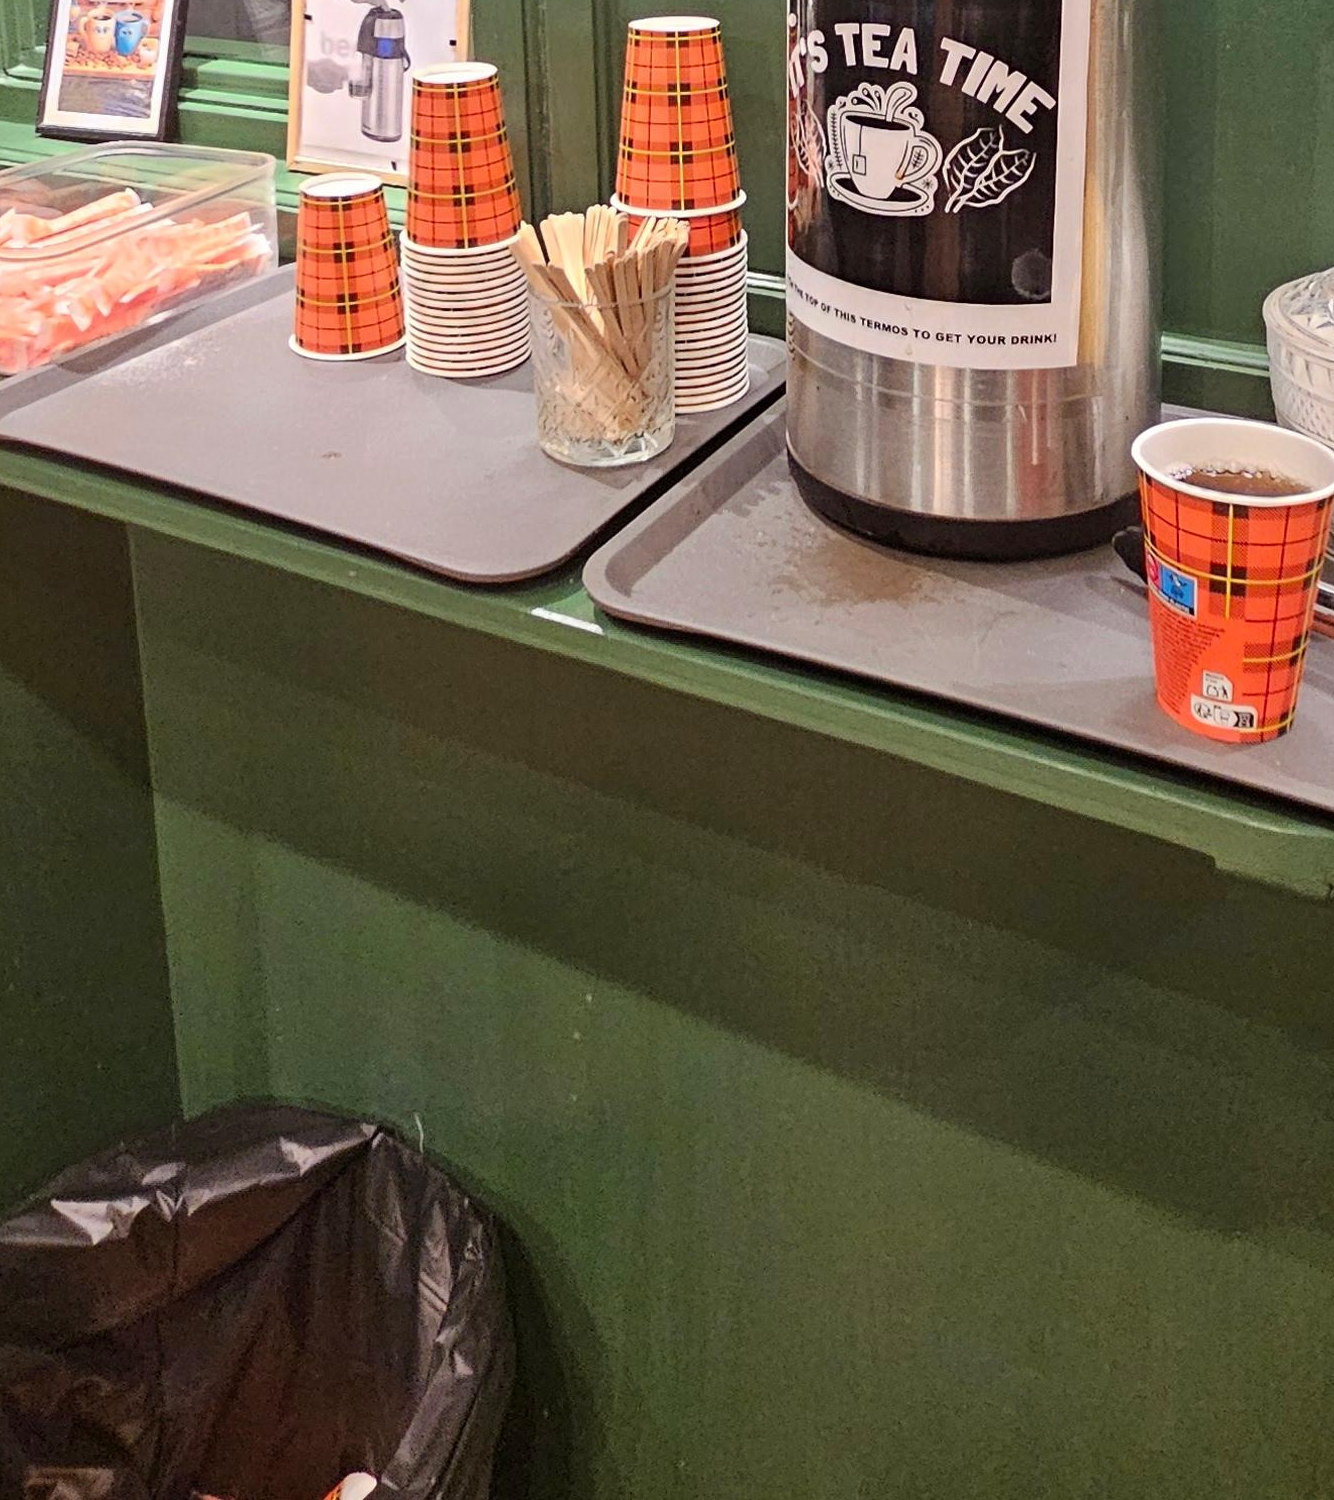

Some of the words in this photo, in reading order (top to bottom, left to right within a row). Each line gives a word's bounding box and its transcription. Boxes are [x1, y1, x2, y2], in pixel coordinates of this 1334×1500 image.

[834, 23, 918, 75] TEA
[939, 36, 1056, 134] TIME
[805, 292, 819, 307] TOP
[820, 302, 831, 314] OF
[833, 307, 857, 324] THIS
[859, 316, 909, 336] TERMOS
[913, 328, 931, 340] TO
[935, 332, 962, 344] GET
[967, 334, 1007, 345] YOUR
[1010, 333, 1057, 345] DRINK!
